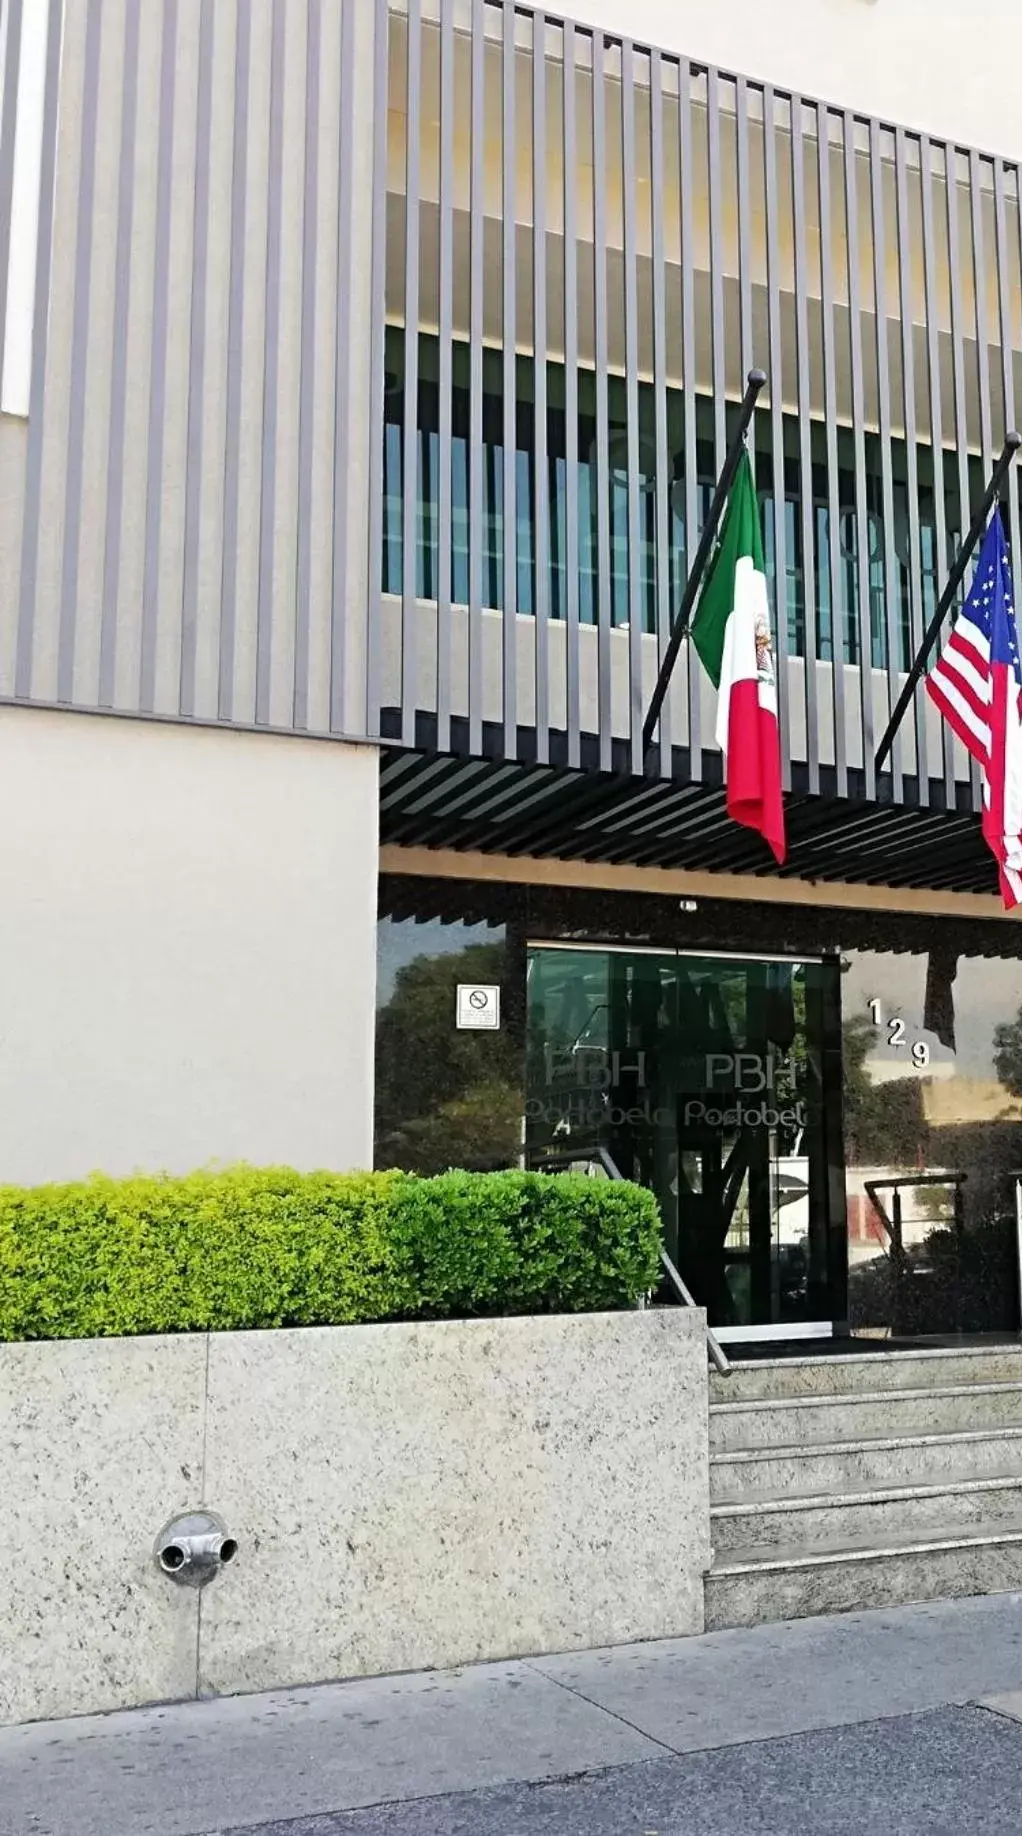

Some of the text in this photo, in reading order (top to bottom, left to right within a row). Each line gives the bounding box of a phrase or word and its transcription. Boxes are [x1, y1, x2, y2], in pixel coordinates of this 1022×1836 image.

[868, 998, 929, 1068] 129
[544, 1047, 646, 1089] PBH
[705, 1053, 797, 1093] PBH
